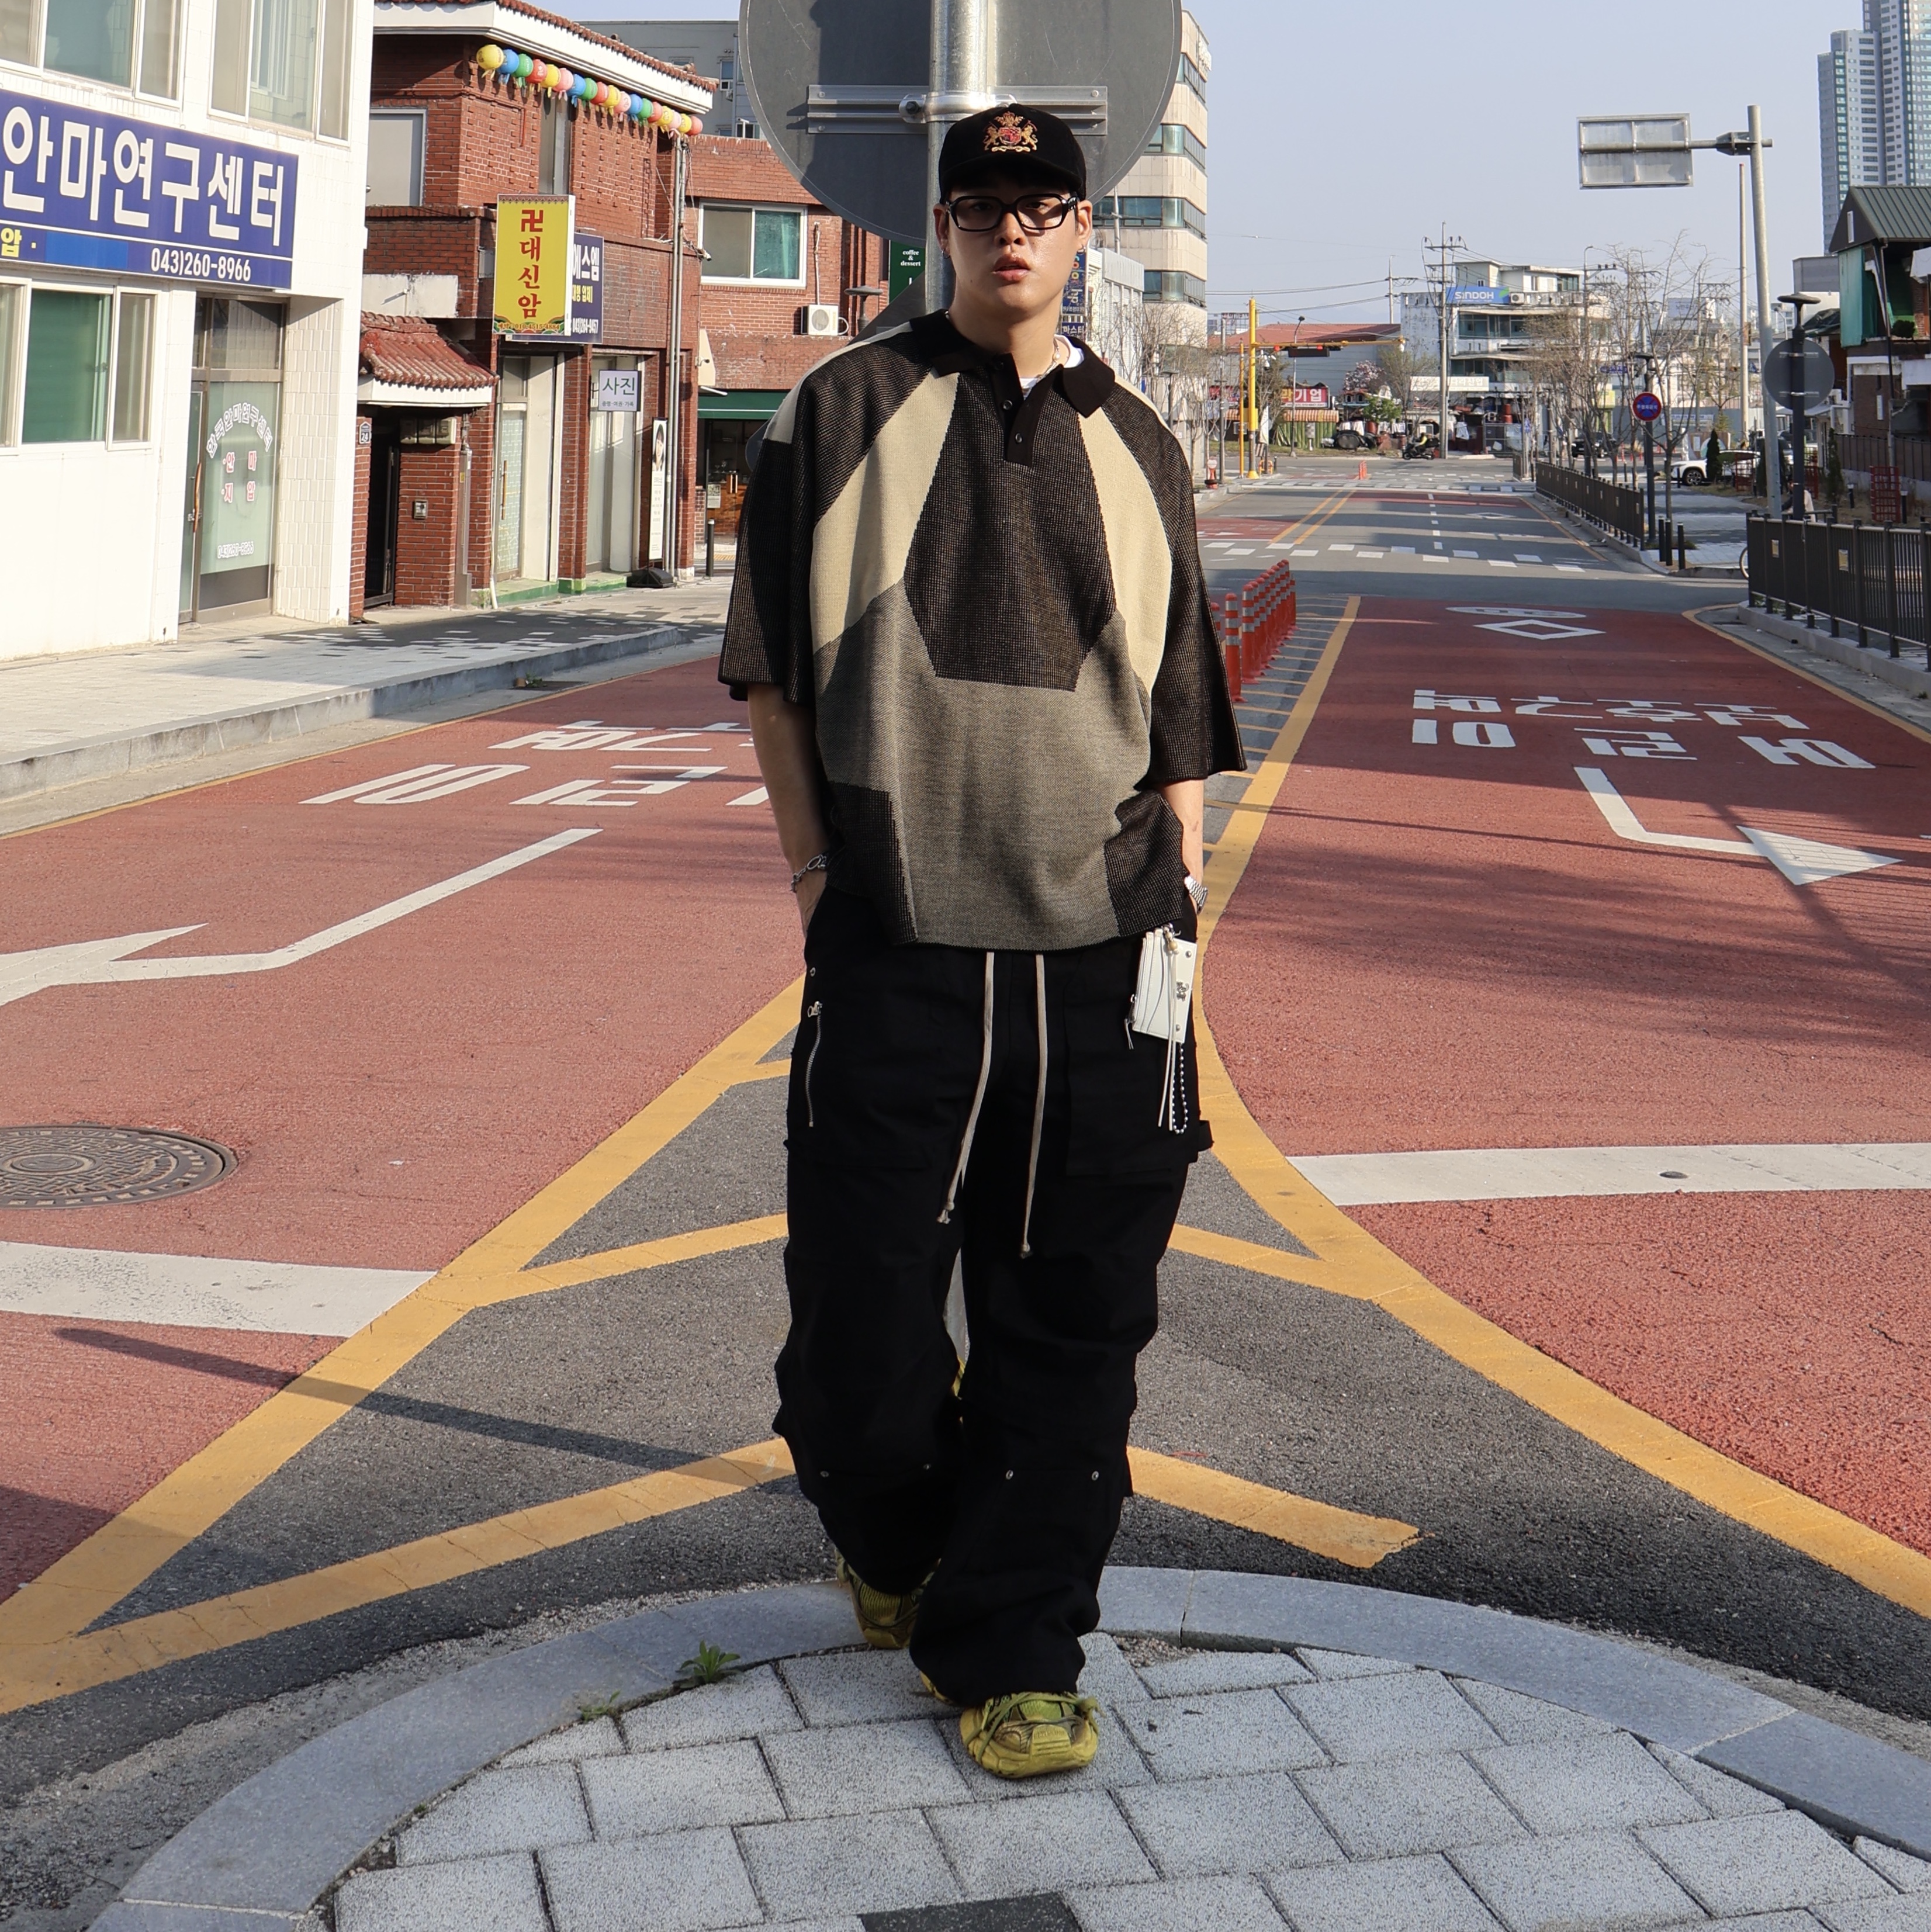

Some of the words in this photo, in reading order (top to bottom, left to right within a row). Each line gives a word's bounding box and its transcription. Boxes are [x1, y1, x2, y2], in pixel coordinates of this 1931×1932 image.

[2, 106, 284, 247] 안마연구센터
[151, 248, 251, 282] 043)260-8966
[517, 234, 542, 319] 대신암
[573, 244, 600, 282] 에스엠
[1063, 325, 1085, 334] 마스터
[603, 377, 635, 395] 사진
[206, 402, 273, 459] 한국안마연구센터
